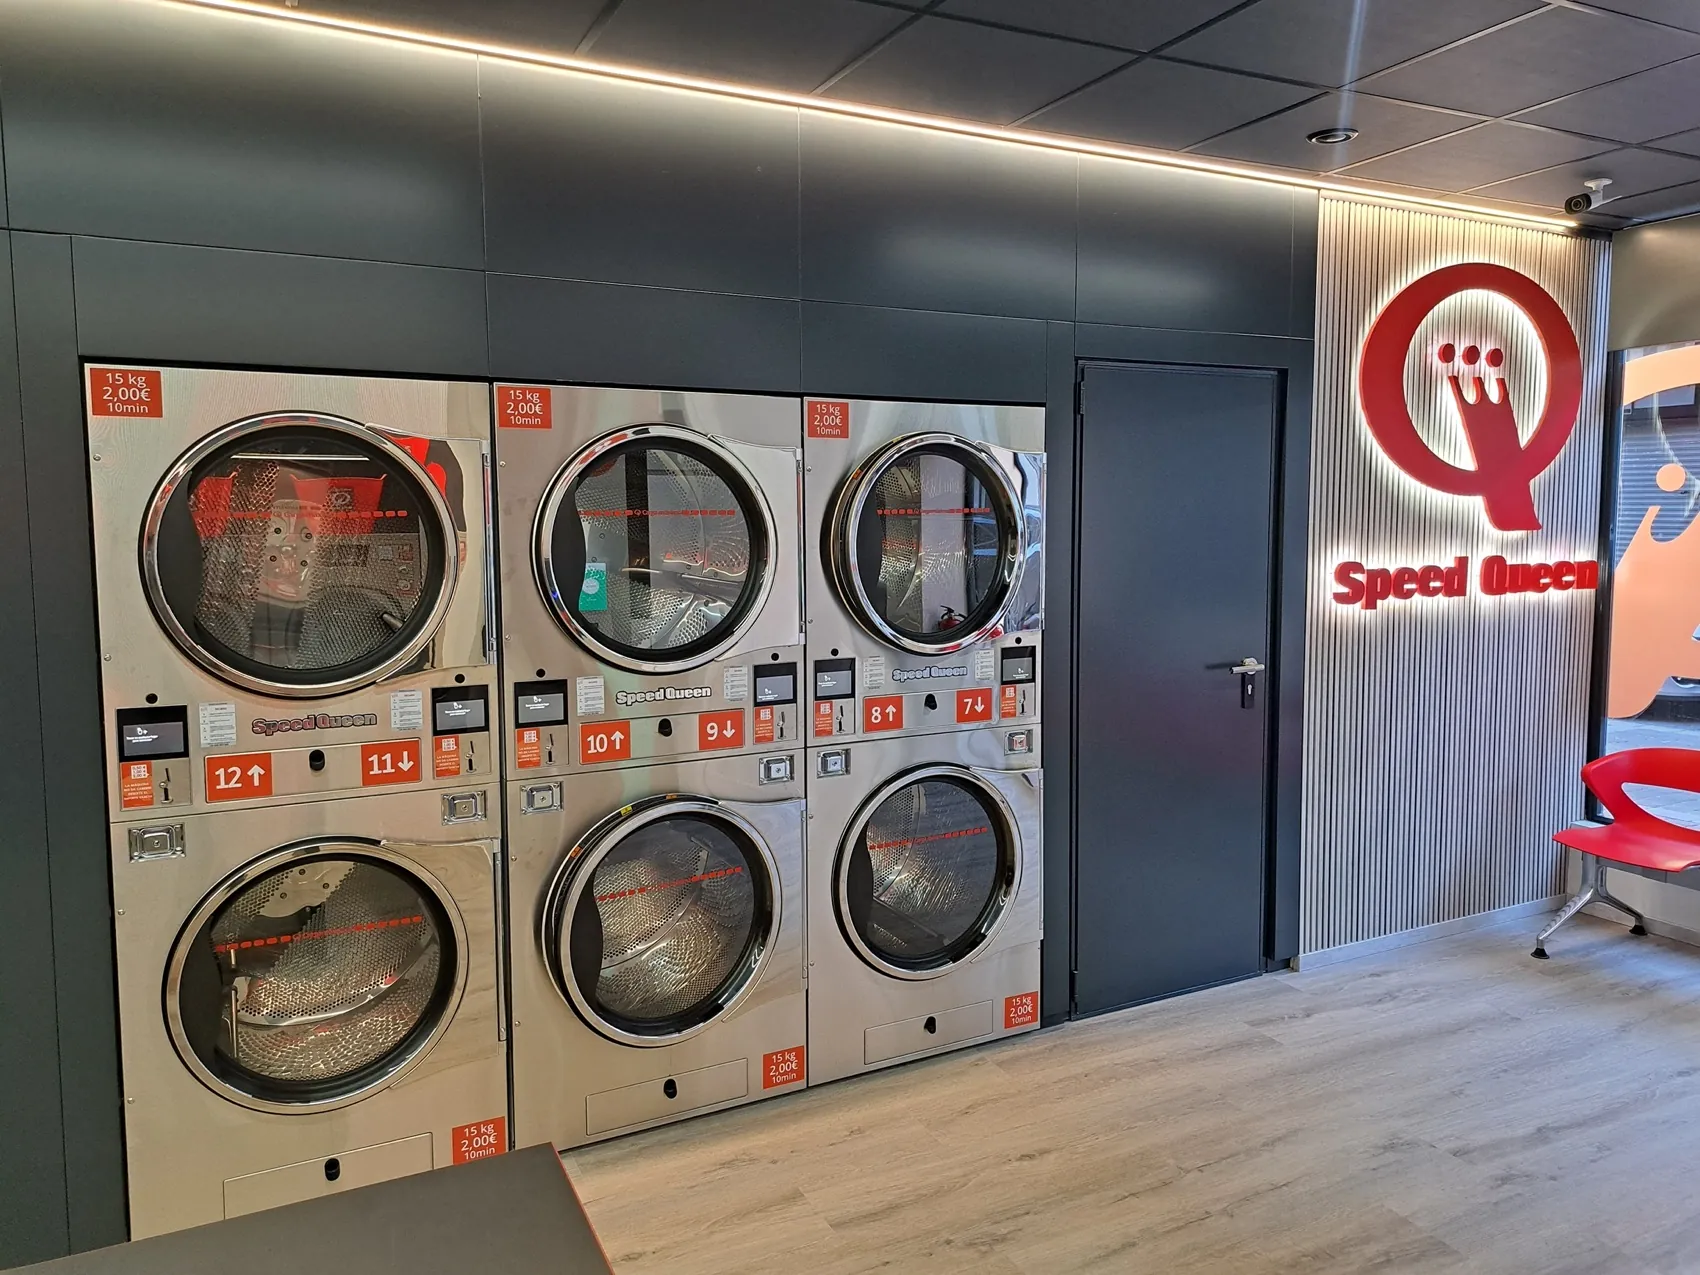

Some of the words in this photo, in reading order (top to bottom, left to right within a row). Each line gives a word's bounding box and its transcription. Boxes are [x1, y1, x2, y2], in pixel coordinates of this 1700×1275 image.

[105, 372, 124, 385] 15
[128, 373, 147, 389] kg
[102, 387, 152, 403] 2,00€
[509, 389, 524, 400] 15
[526, 390, 540, 403] kg
[1358, 262, 1583, 532] Q
[107, 402, 149, 413] 10min
[506, 402, 544, 417] 2,00€
[816, 404, 827, 413] 15
[829, 405, 841, 416] kg
[509, 415, 542, 425] 10min
[813, 414, 843, 427] 2,00€
[816, 426, 841, 436] 10min
[1333, 556, 1469, 610] Speed
[1480, 555, 1598, 596] Queen
[892, 666, 930, 683] Speed
[930, 666, 967, 679] Queen
[615, 687, 665, 706] Speed
[665, 687, 712, 700] Queen
[963, 698, 973, 715] 7
[871, 706, 882, 724] 8
[251, 714, 316, 737] Speed
[316, 713, 378, 730] Queen
[706, 722, 719, 741] 9
[587, 733, 608, 754] 10
[368, 752, 396, 775] 11
[215, 766, 242, 790] 12
[1012, 997, 1021, 1006] 15
[1022, 996, 1032, 1005] kg
[1010, 1003, 1033, 1018] 2,00€
[1011, 1015, 1032, 1025] 10min
[772, 1052, 783, 1063] 15
[784, 1050, 796, 1061] kg
[770, 1059, 798, 1076] 2,00€
[772, 1072, 797, 1084] 10min
[464, 1126, 478, 1138] 15
[480, 1123, 495, 1135] kg
[460, 1132, 498, 1152] 2,00€
[464, 1146, 496, 1160] 10min
